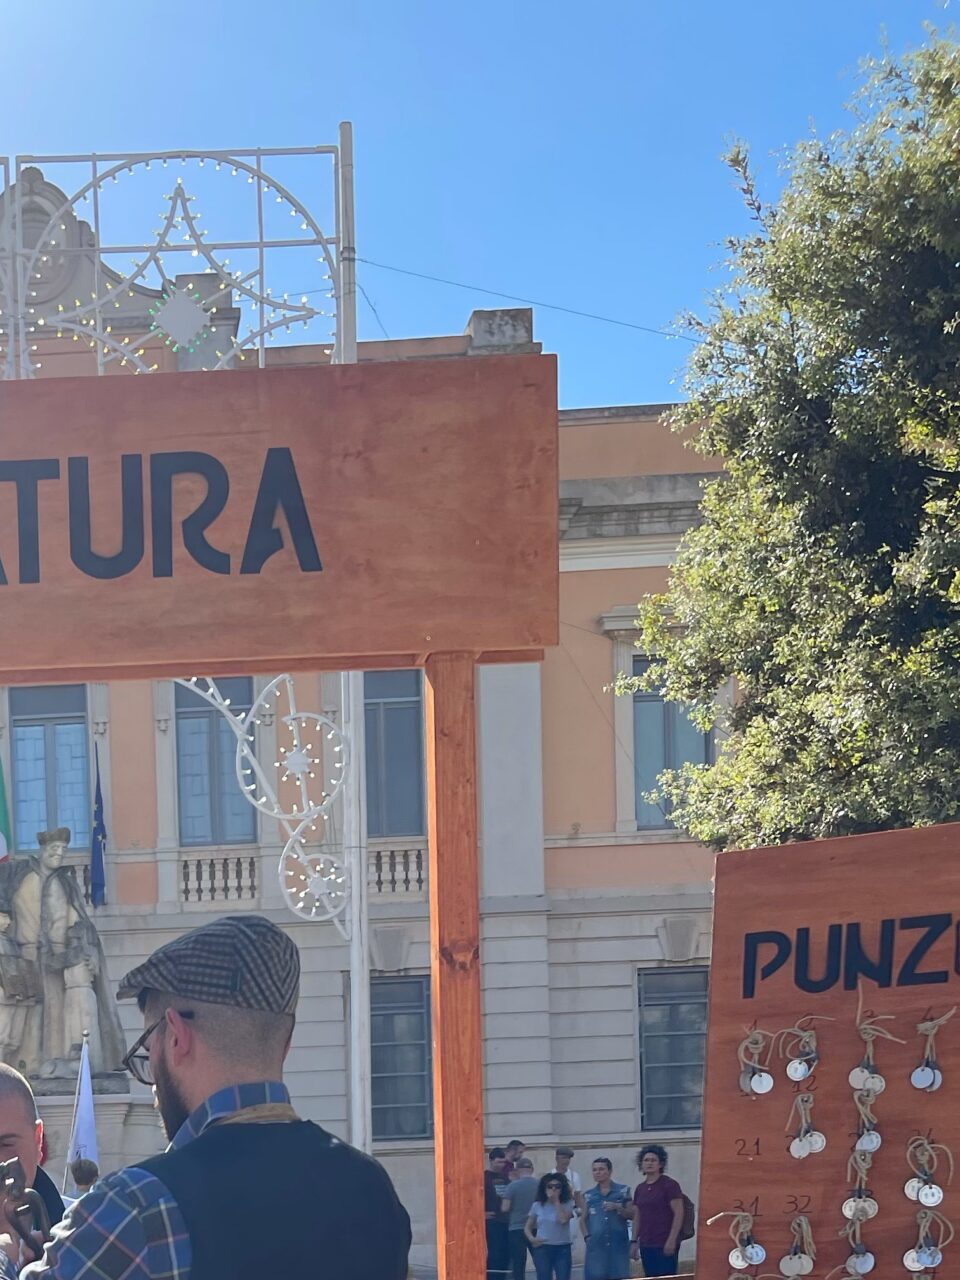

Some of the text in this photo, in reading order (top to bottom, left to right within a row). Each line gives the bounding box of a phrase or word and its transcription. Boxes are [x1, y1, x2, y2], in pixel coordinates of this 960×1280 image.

[743, 913, 960, 998] PUNZ
[734, 1138, 761, 1156] 21
[783, 1196, 812, 1214] 32
